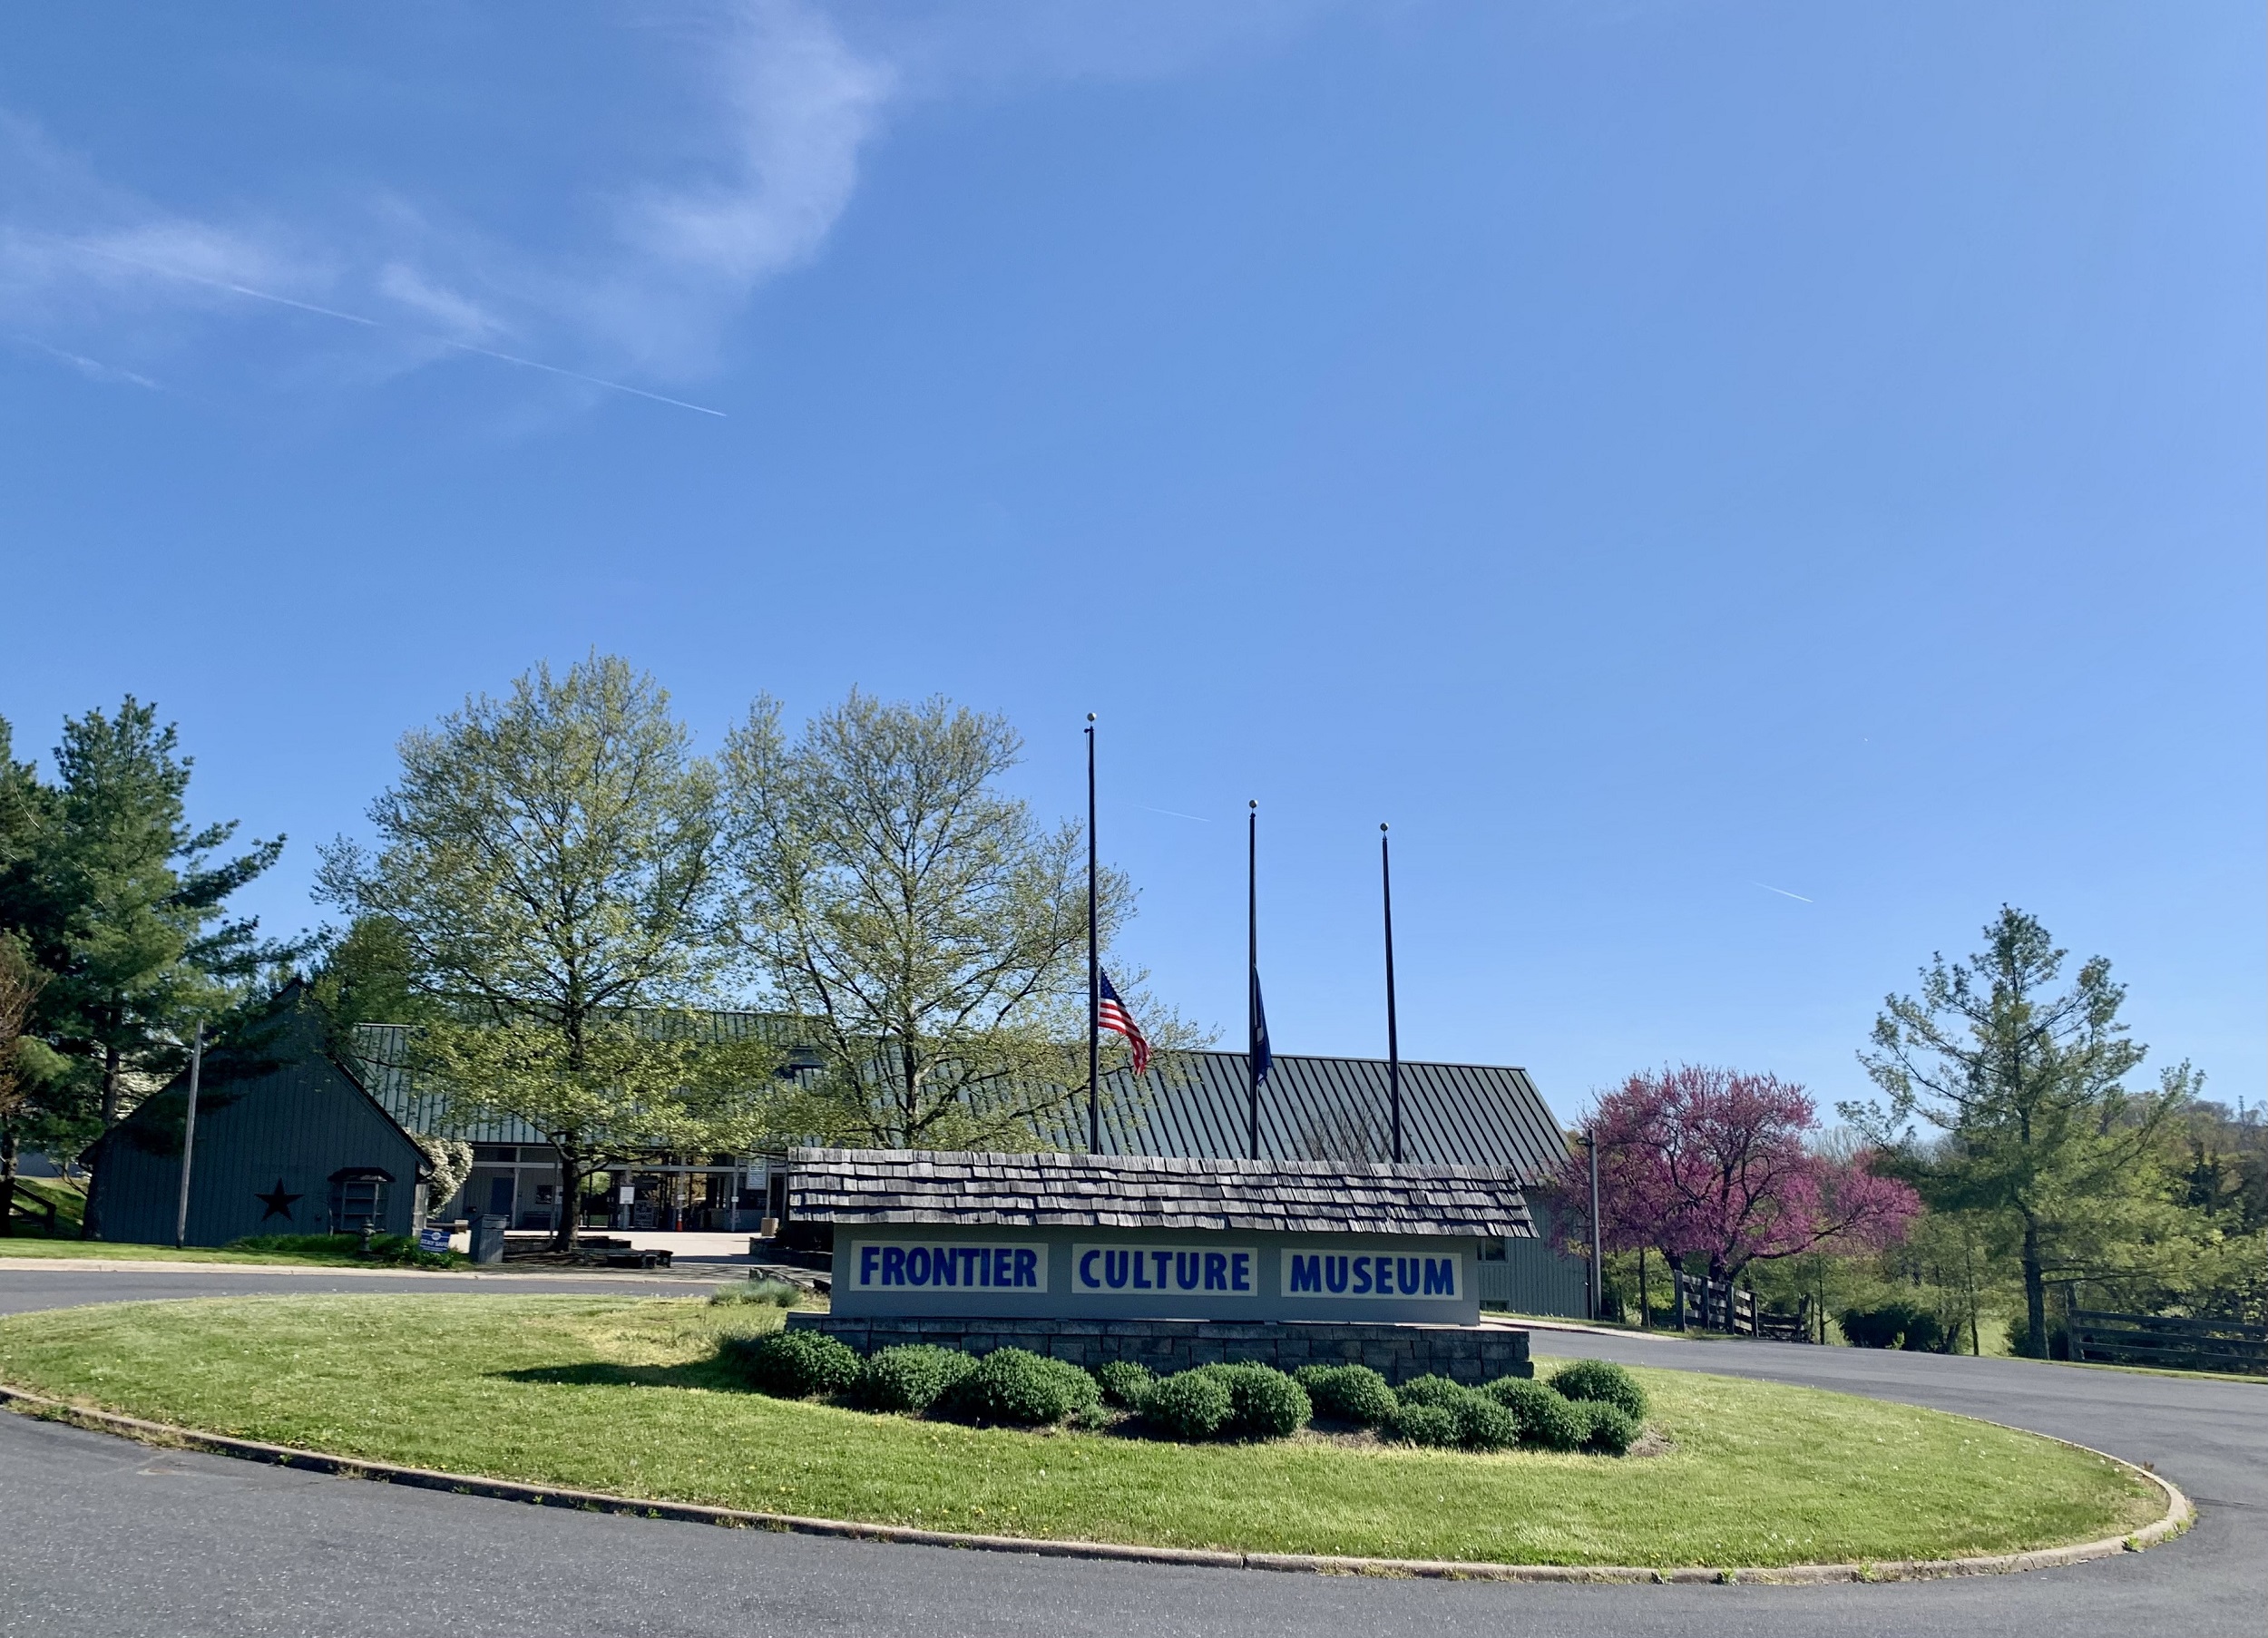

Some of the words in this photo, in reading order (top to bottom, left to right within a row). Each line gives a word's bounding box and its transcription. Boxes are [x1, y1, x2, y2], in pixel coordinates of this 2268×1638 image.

[860, 1246, 1037, 1287] FRONTIER
[1080, 1249, 1250, 1291] CULTURE
[1290, 1254, 1455, 1295] MUSEUM
